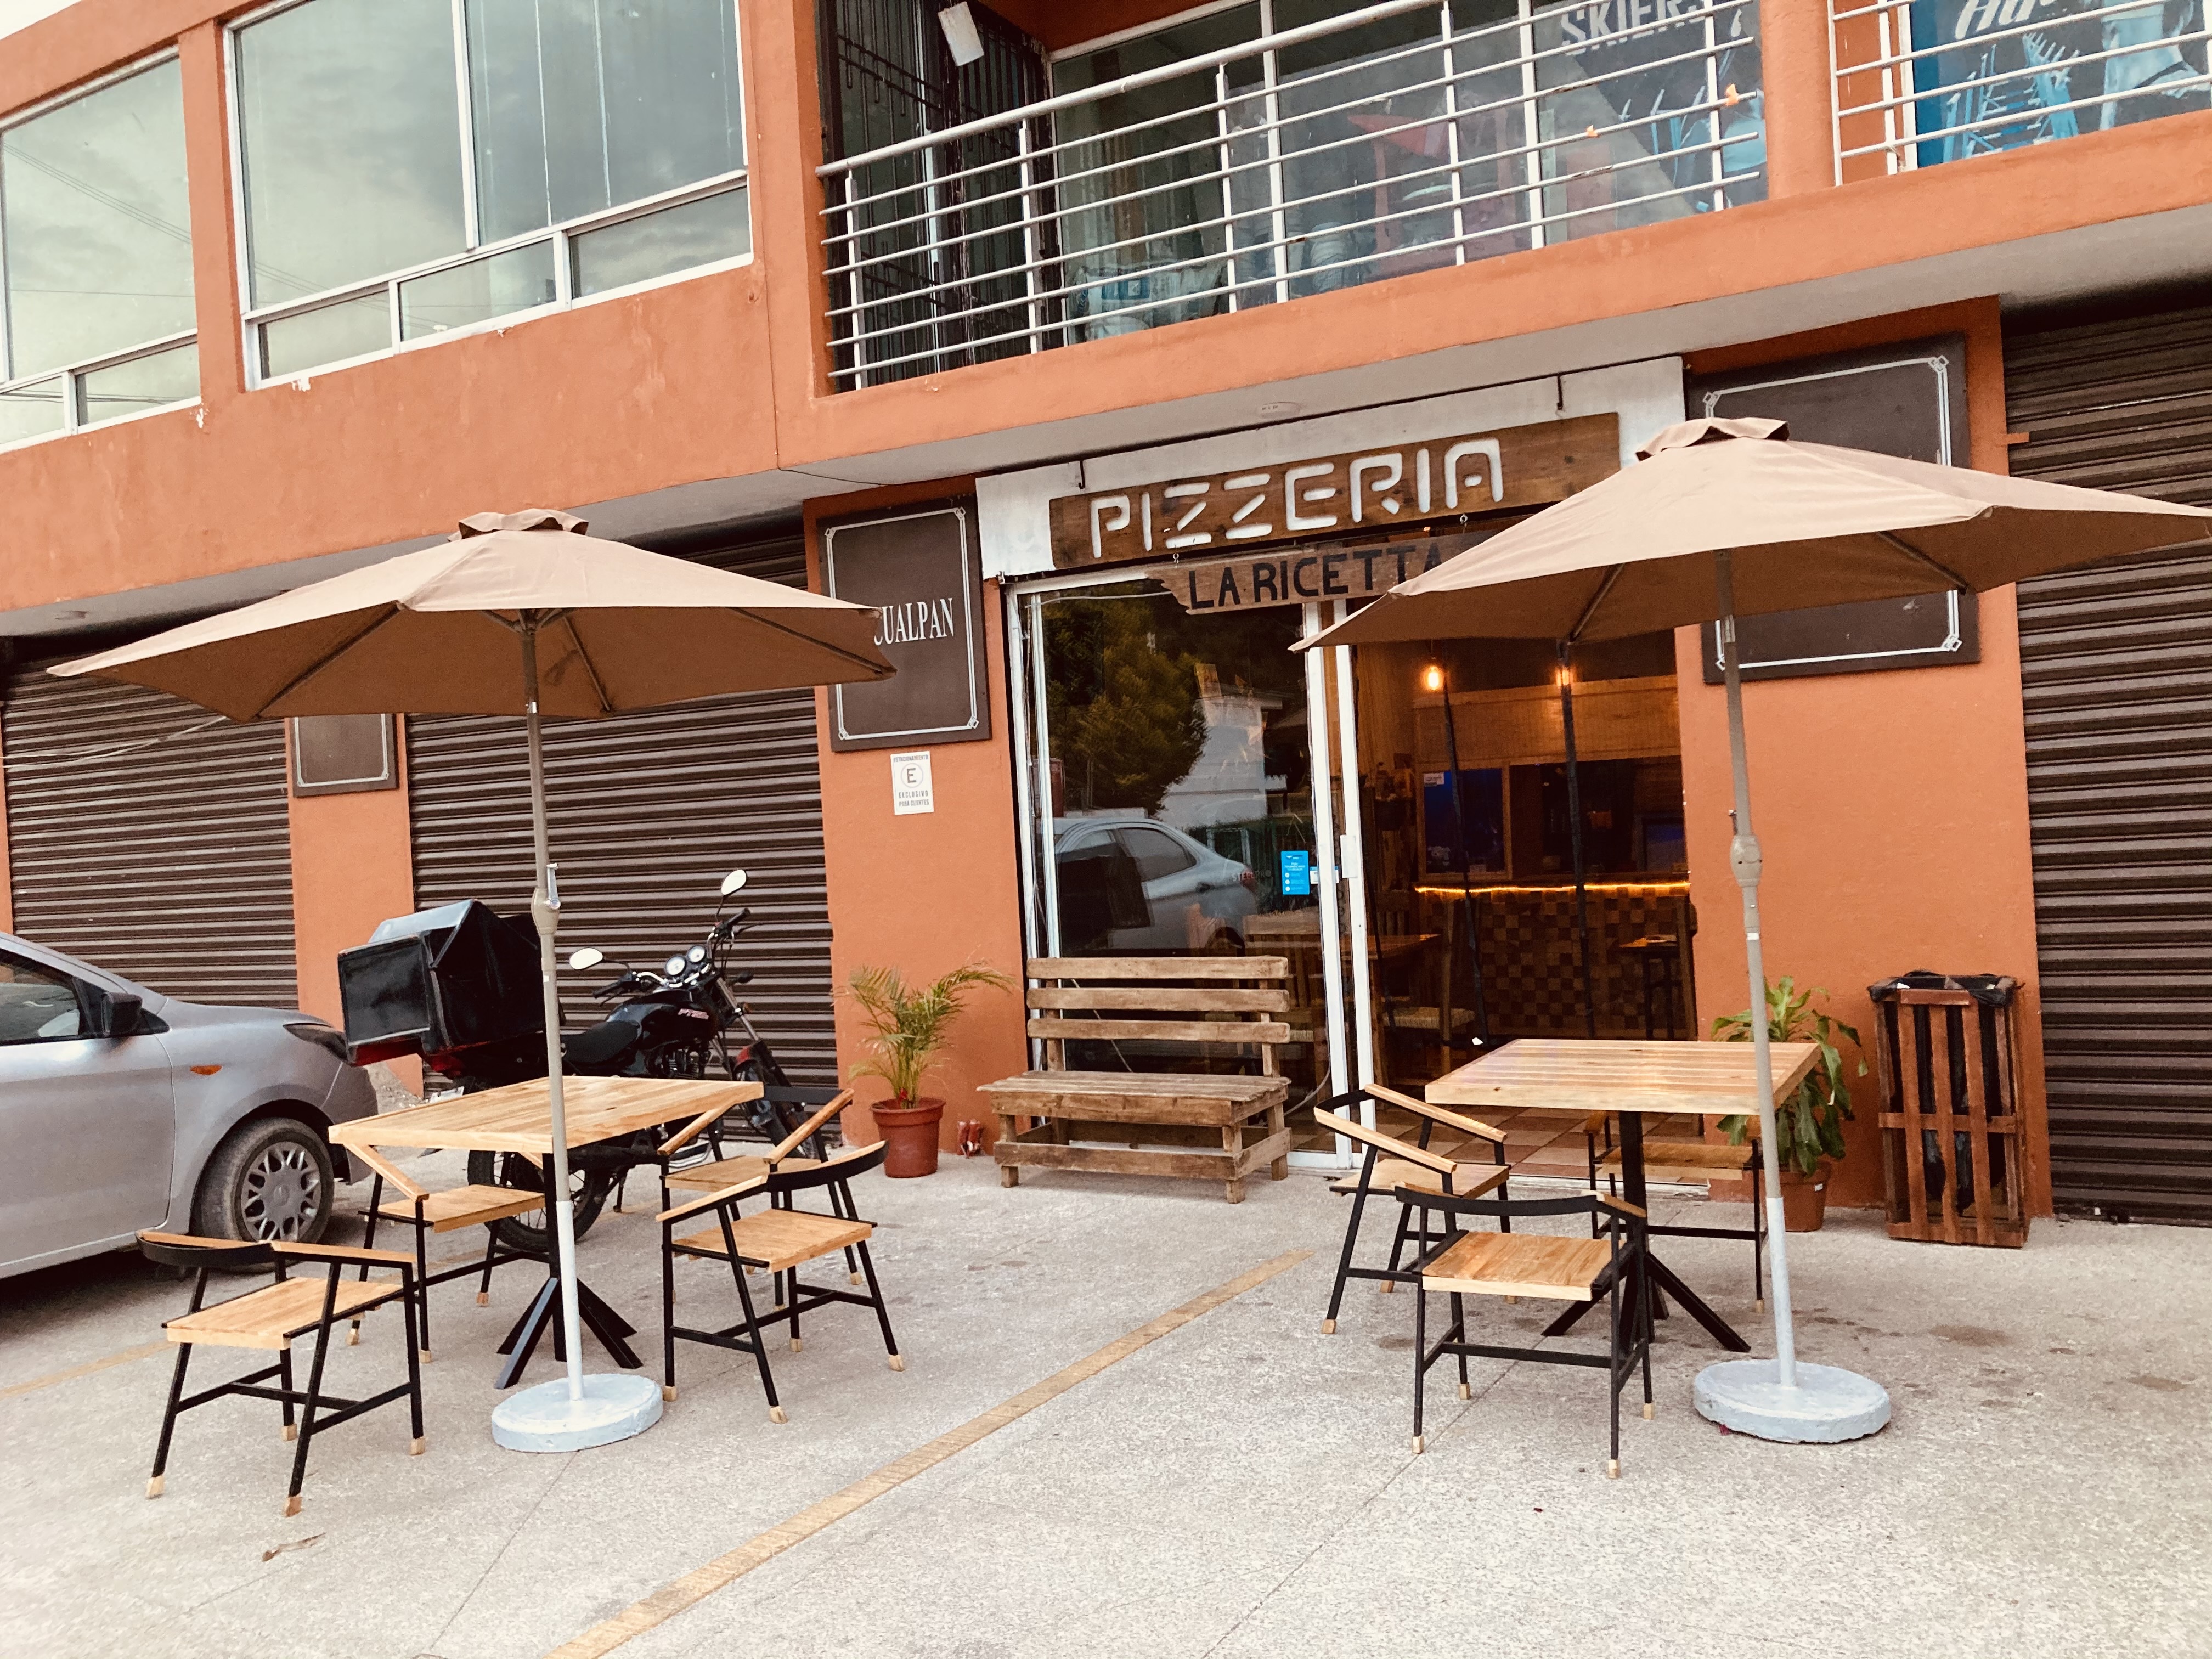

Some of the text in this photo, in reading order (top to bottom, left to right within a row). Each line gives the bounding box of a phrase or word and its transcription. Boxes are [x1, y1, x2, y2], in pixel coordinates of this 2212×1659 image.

[1091, 438, 1504, 559] PIZZERIA
[1188, 541, 1442, 610] LA RICETTA
[874, 597, 954, 646] UALPAN
[899, 790, 928, 799] EXCLUSIVO
[907, 768, 917, 783] E
